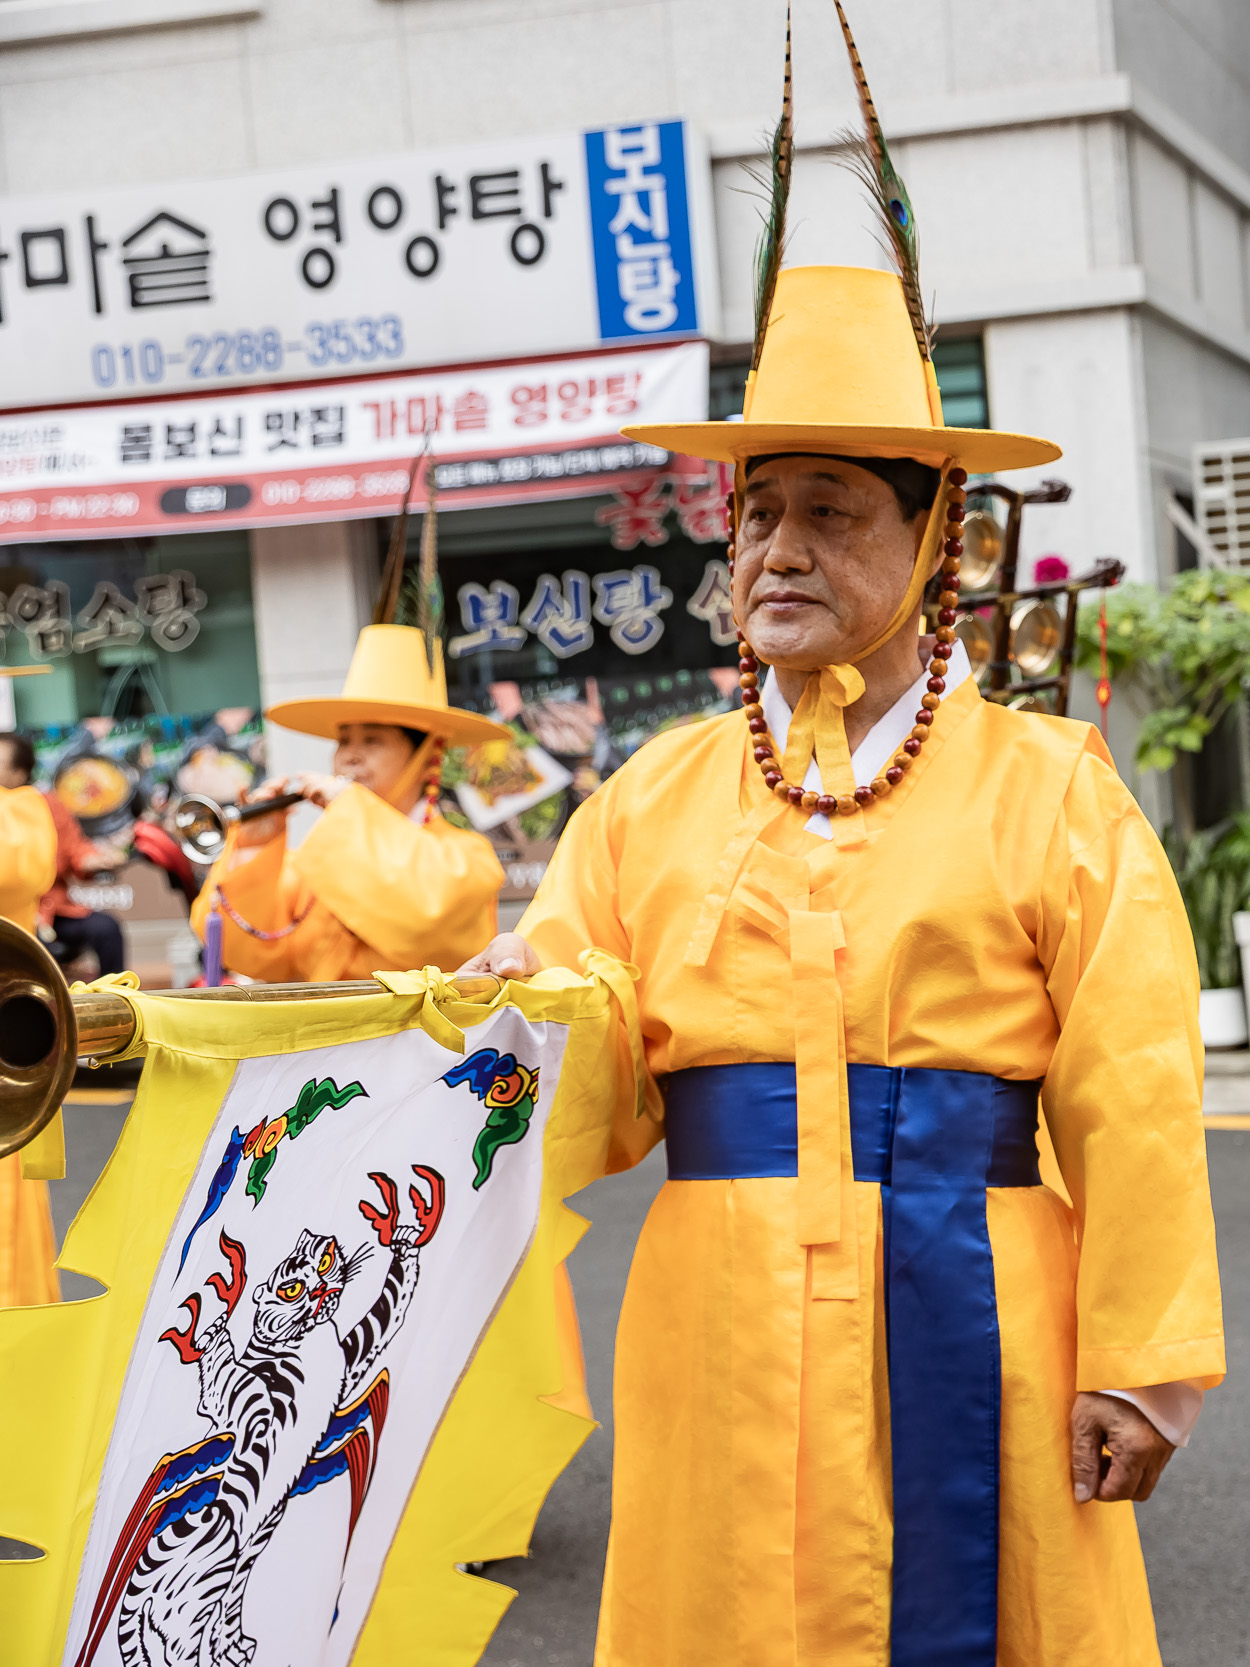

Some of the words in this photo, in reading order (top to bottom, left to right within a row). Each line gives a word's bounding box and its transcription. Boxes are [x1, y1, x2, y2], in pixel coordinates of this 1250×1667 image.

[263, 162, 564, 290] 영양탕
[603, 124, 682, 333] 보신탕
[92, 314, 405, 389] 010-2288-3533
[119, 416, 243, 464] 몸보신
[264, 404, 346, 451] 맛집
[362, 389, 489, 440] 가마솥
[511, 371, 643, 427] 영양탕
[0, 569, 207, 661] 염소탕
